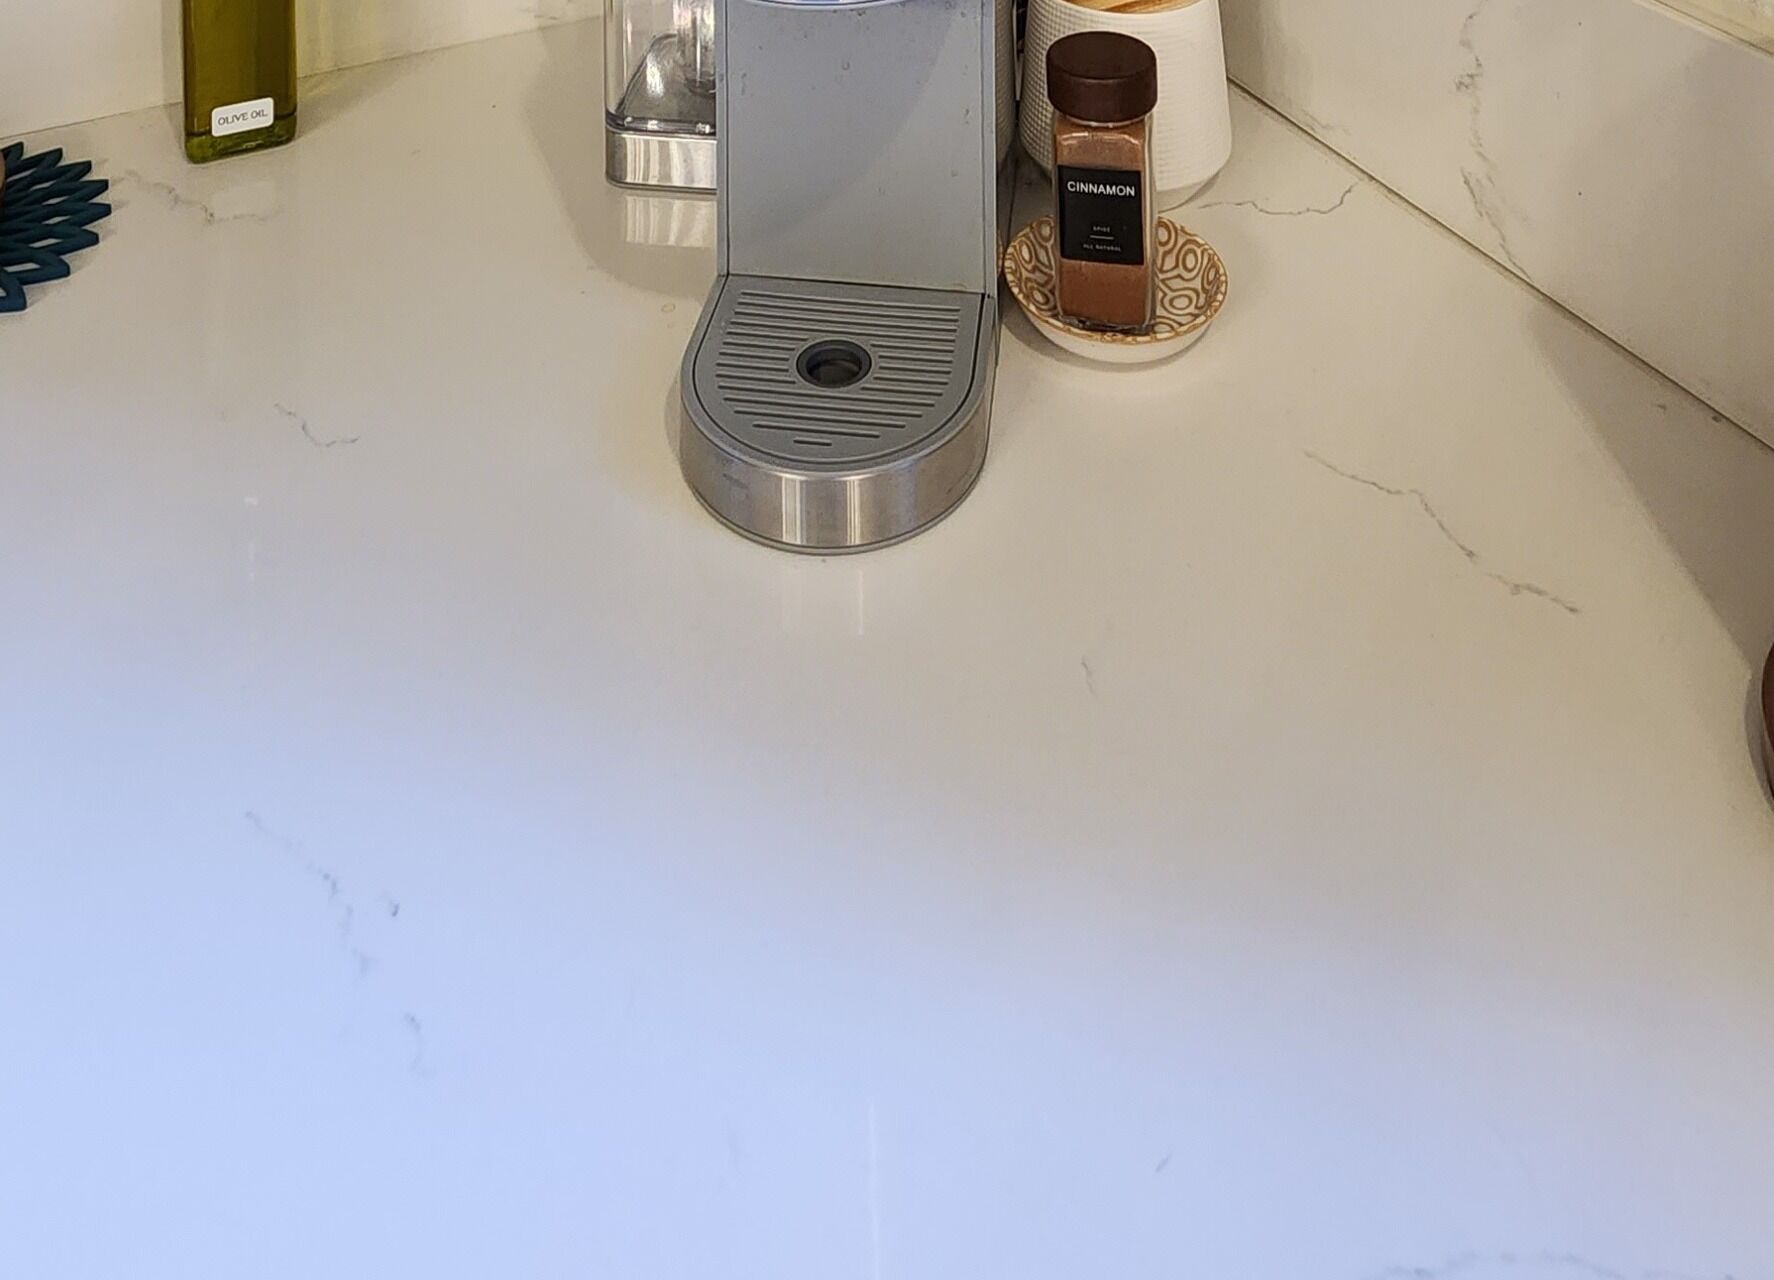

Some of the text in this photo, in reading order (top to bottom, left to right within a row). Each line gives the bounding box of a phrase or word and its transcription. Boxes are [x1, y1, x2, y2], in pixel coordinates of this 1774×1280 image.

[217, 109, 268, 126] OLIVE OIL
[1066, 180, 1136, 197] CINNAMON
